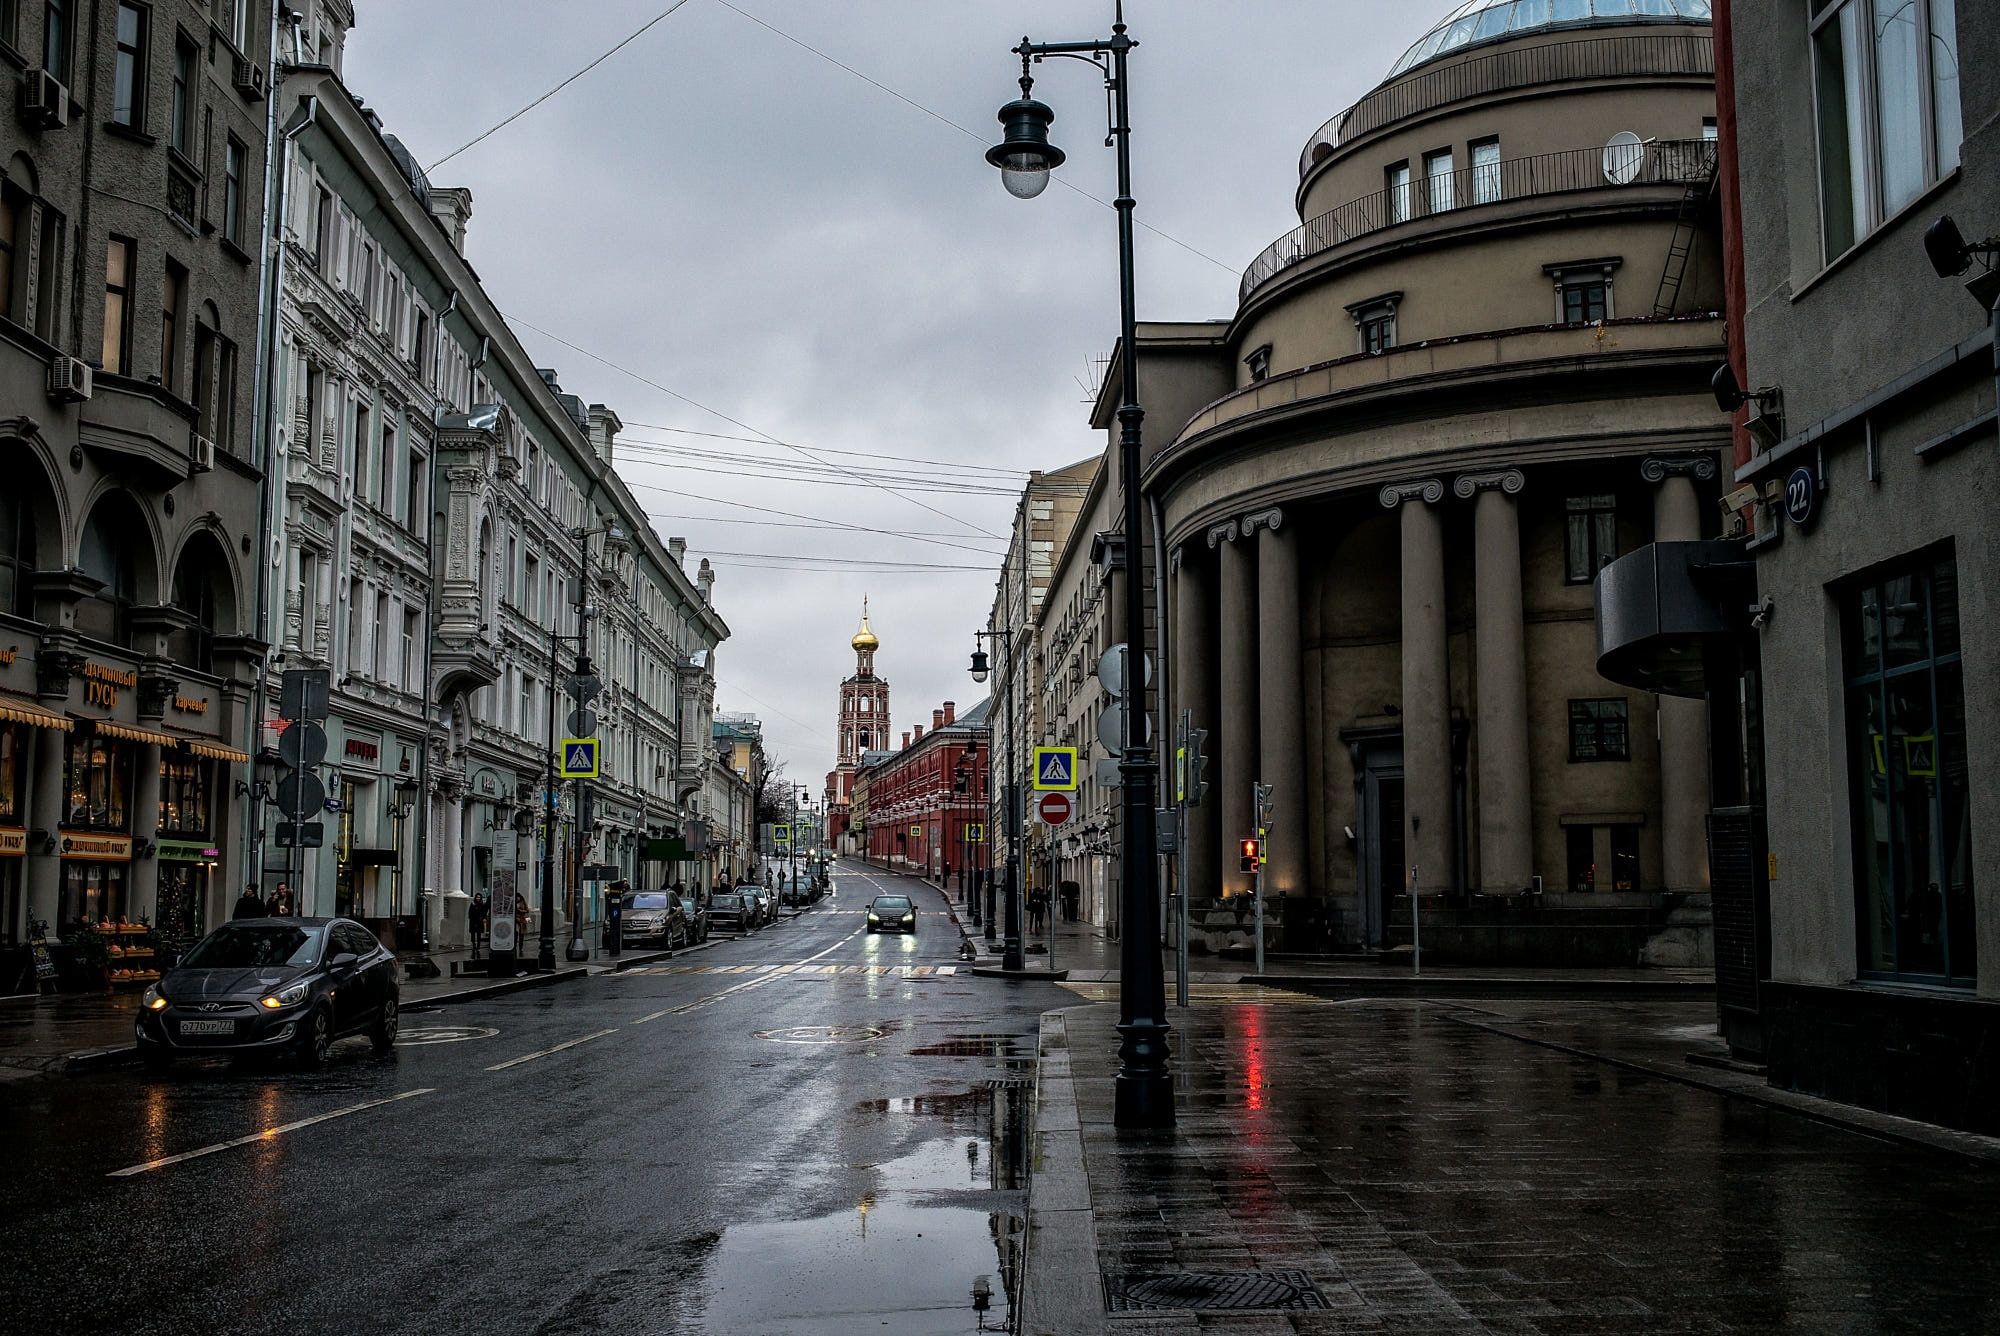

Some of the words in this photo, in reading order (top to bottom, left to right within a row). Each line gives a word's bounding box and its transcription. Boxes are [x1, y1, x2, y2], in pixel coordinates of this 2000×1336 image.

[1789, 479, 1807, 512] 22
[89, 682, 118, 707] ГУСЬ
[1250, 857, 1259, 872] 2
